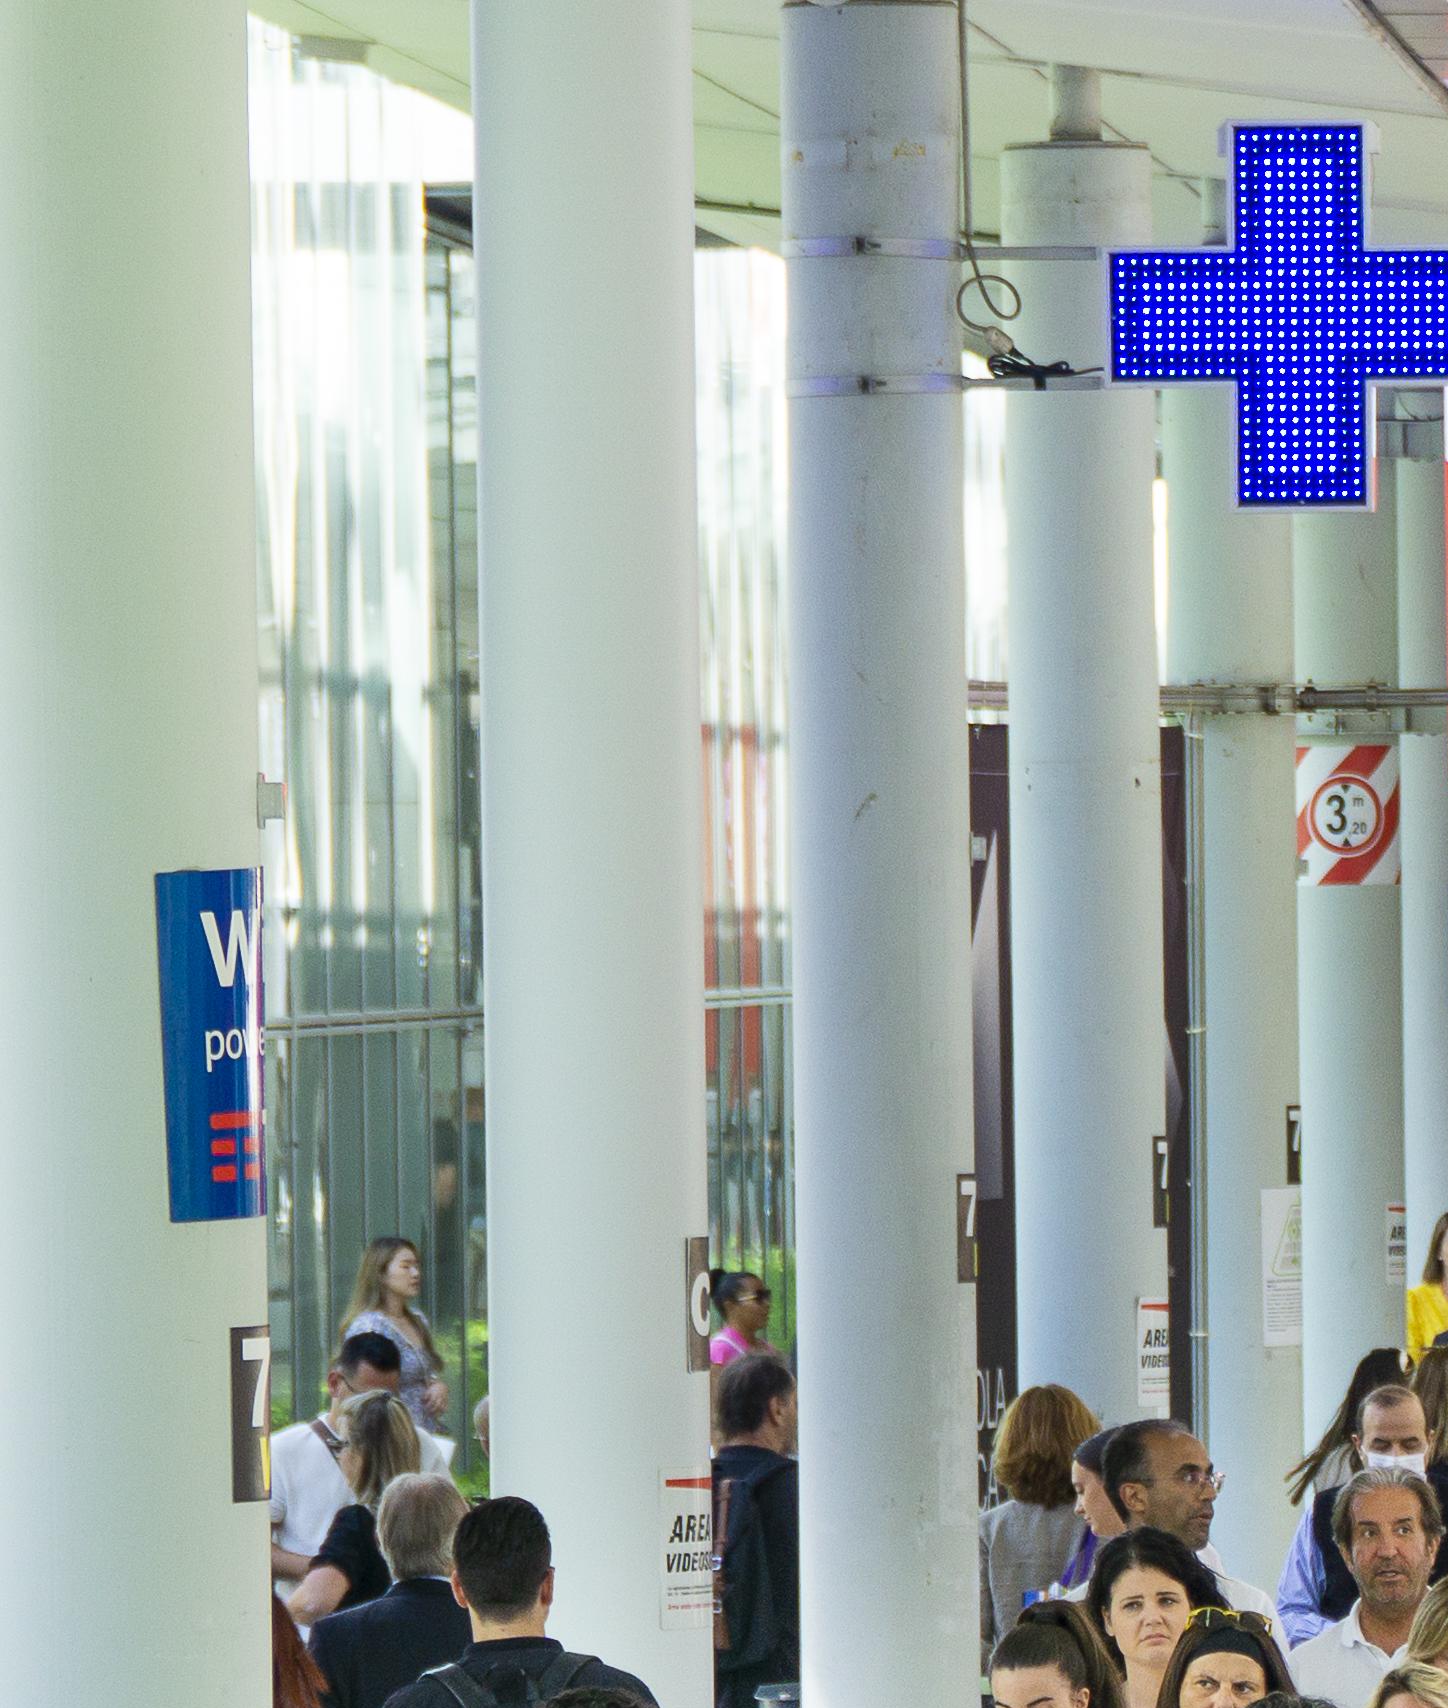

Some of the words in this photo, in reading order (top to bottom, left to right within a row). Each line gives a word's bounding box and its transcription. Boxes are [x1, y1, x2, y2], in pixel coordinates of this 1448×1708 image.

[1326, 794, 1347, 835] 3
[960, 1180, 977, 1237] 7
[242, 1337, 270, 1430] 7
